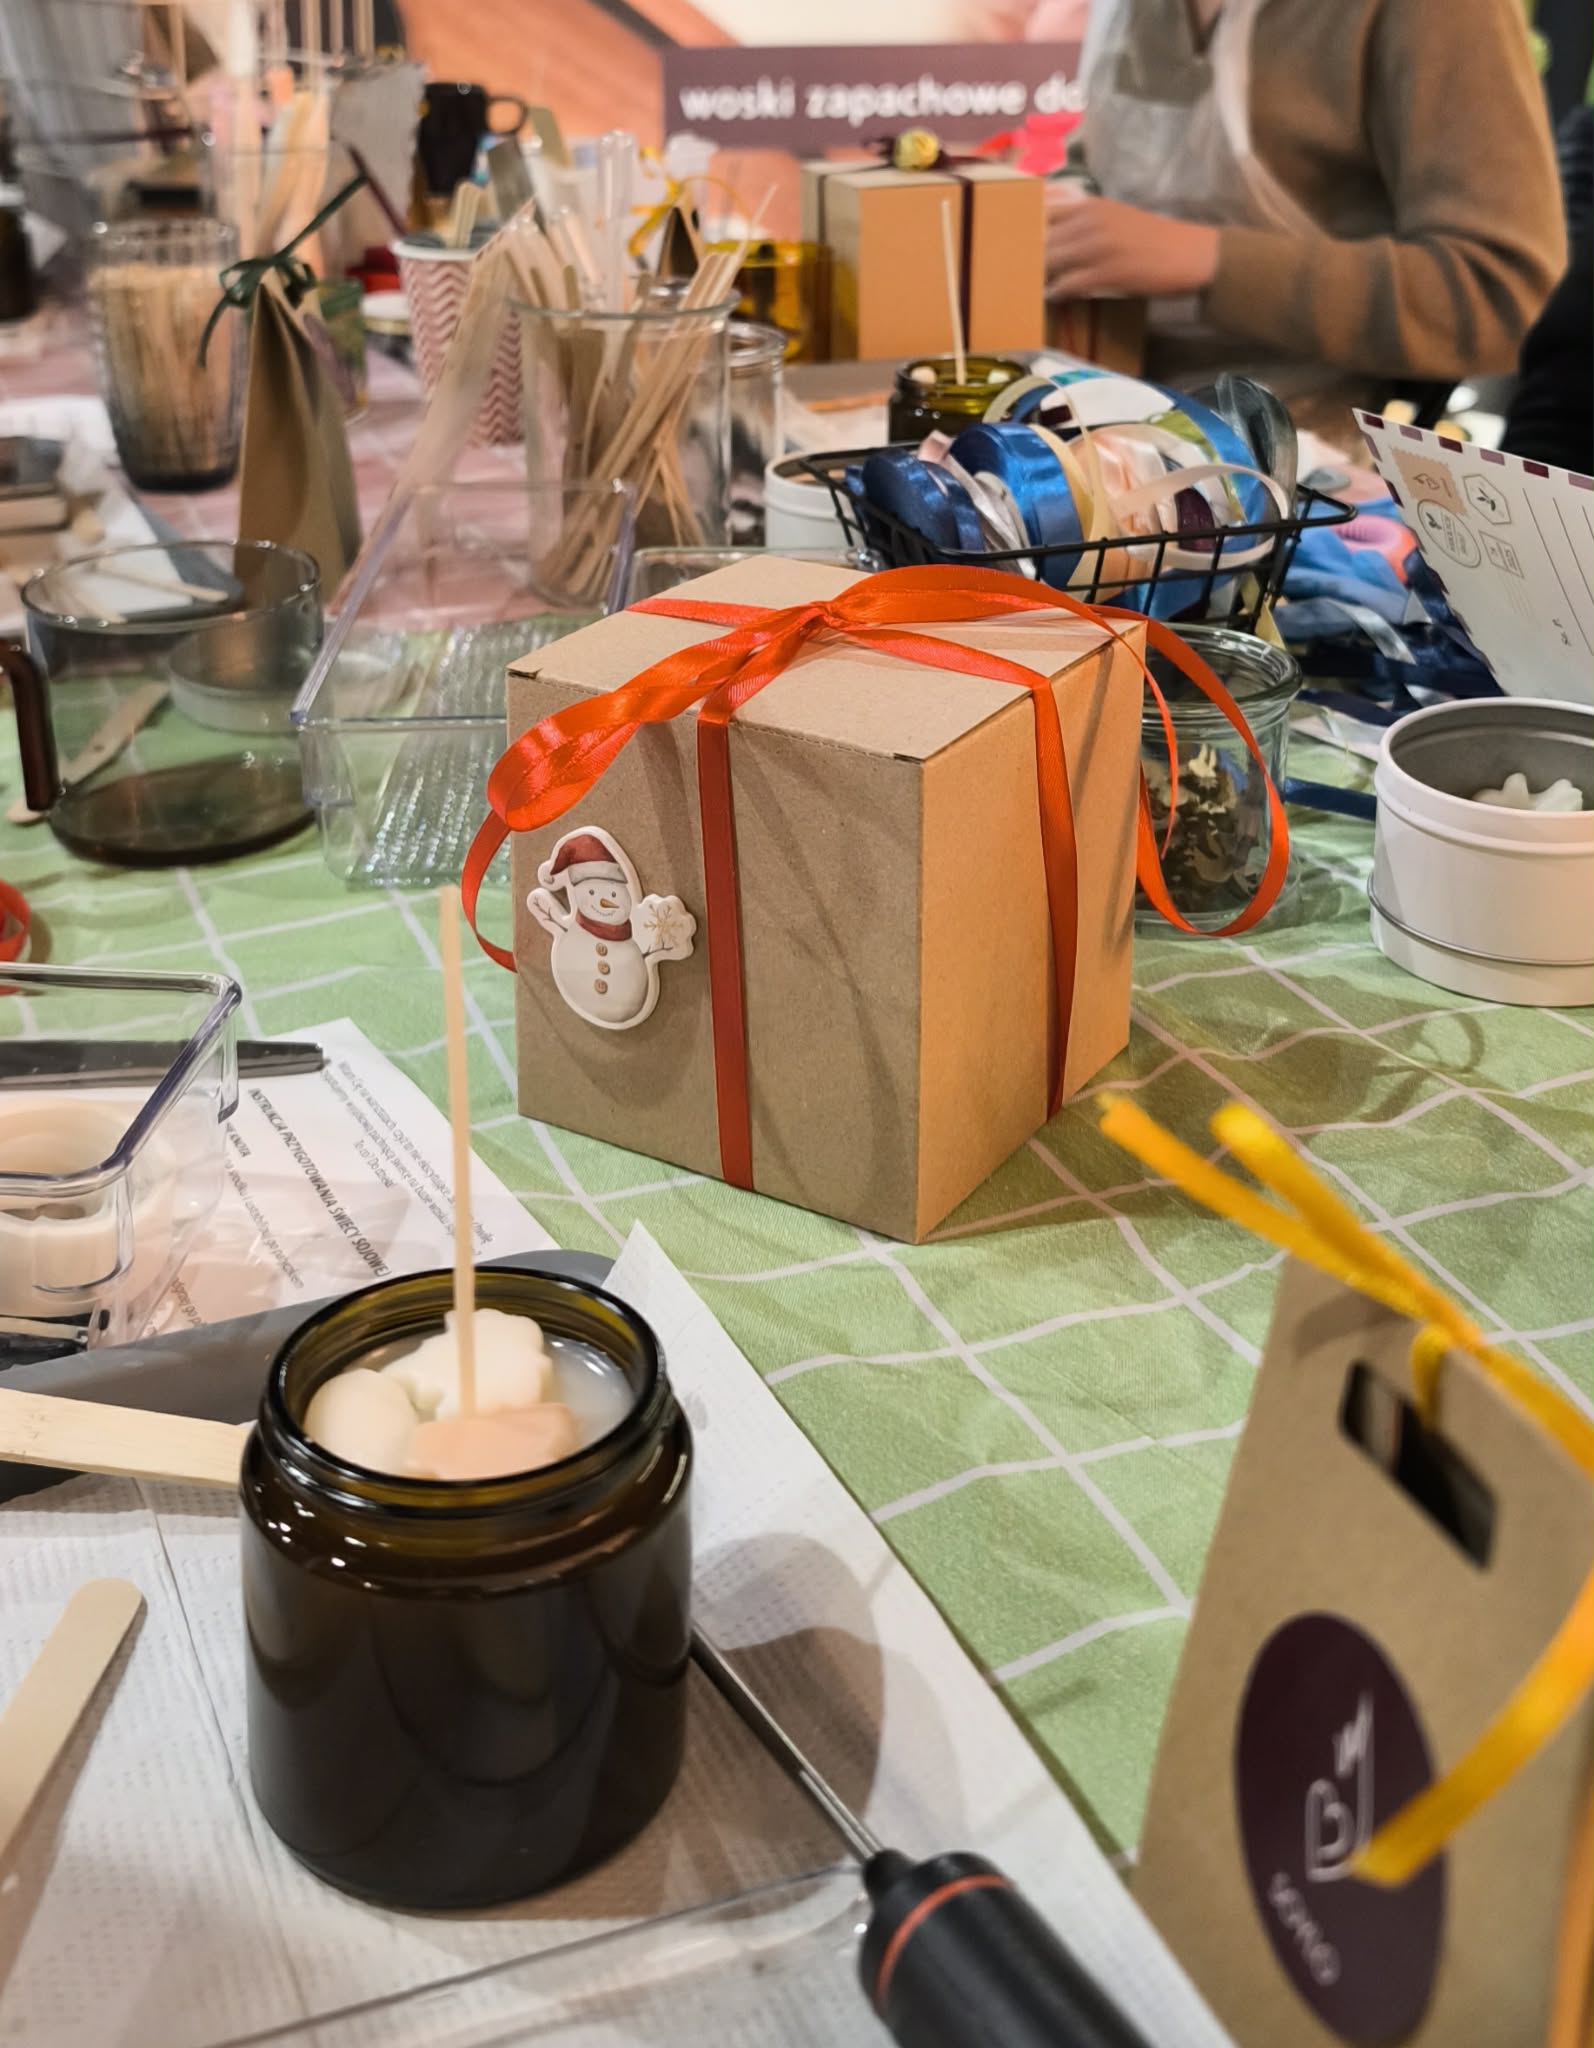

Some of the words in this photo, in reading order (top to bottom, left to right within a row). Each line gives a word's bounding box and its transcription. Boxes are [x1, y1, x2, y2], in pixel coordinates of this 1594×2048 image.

[679, 75, 795, 120] woski
[805, 74, 1026, 126] zapachowe
[249, 1088, 288, 1132] INSTRUKCJA
[280, 1131, 338, 1208] PRZYGOTOWANIA
[328, 1207, 362, 1239] ŚWIECY
[352, 1238, 392, 1278] SOJOWEJ
